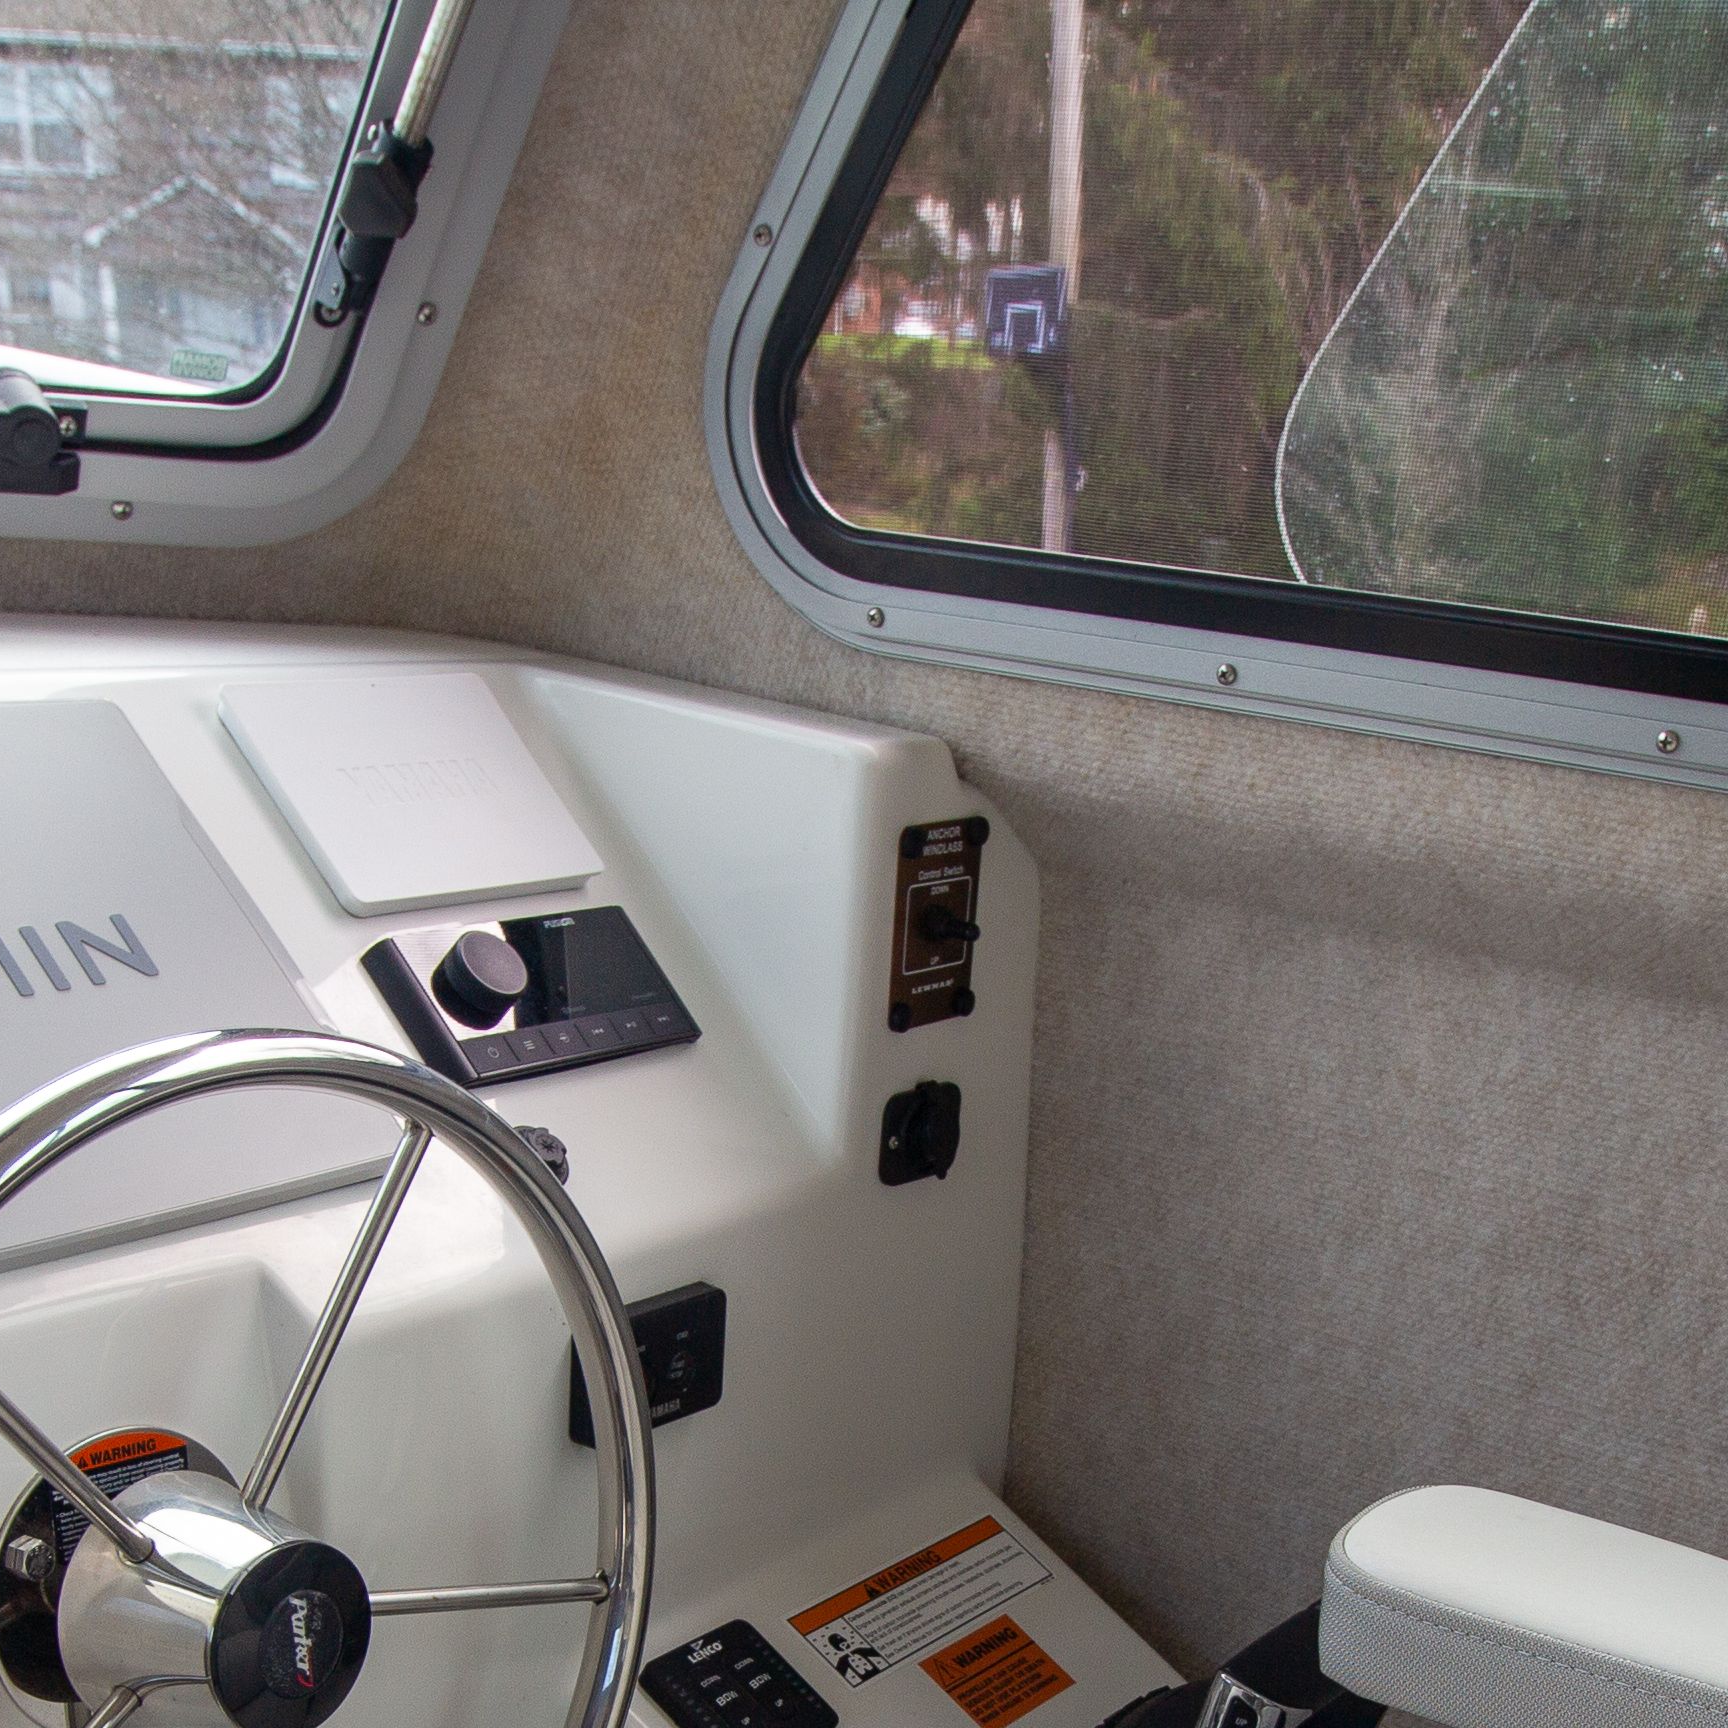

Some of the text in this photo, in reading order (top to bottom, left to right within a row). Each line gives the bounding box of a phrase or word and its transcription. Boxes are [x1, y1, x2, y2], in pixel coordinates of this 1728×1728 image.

[926, 826, 961, 841] ANCHOR
[922, 841, 963, 857] WINDLASS
[918, 868, 941, 880] Control
[90, 1439, 156, 1465] WARNING
[874, 1549, 942, 1592] WARNING
[289, 1597, 312, 1682] Parker
[952, 1626, 1019, 1669] WARNING
[687, 1641, 722, 1664] LENCO
[748, 1672, 772, 1690] BOW
[715, 1690, 739, 1707] BOW
[1235, 1717, 1248, 1727] UP
